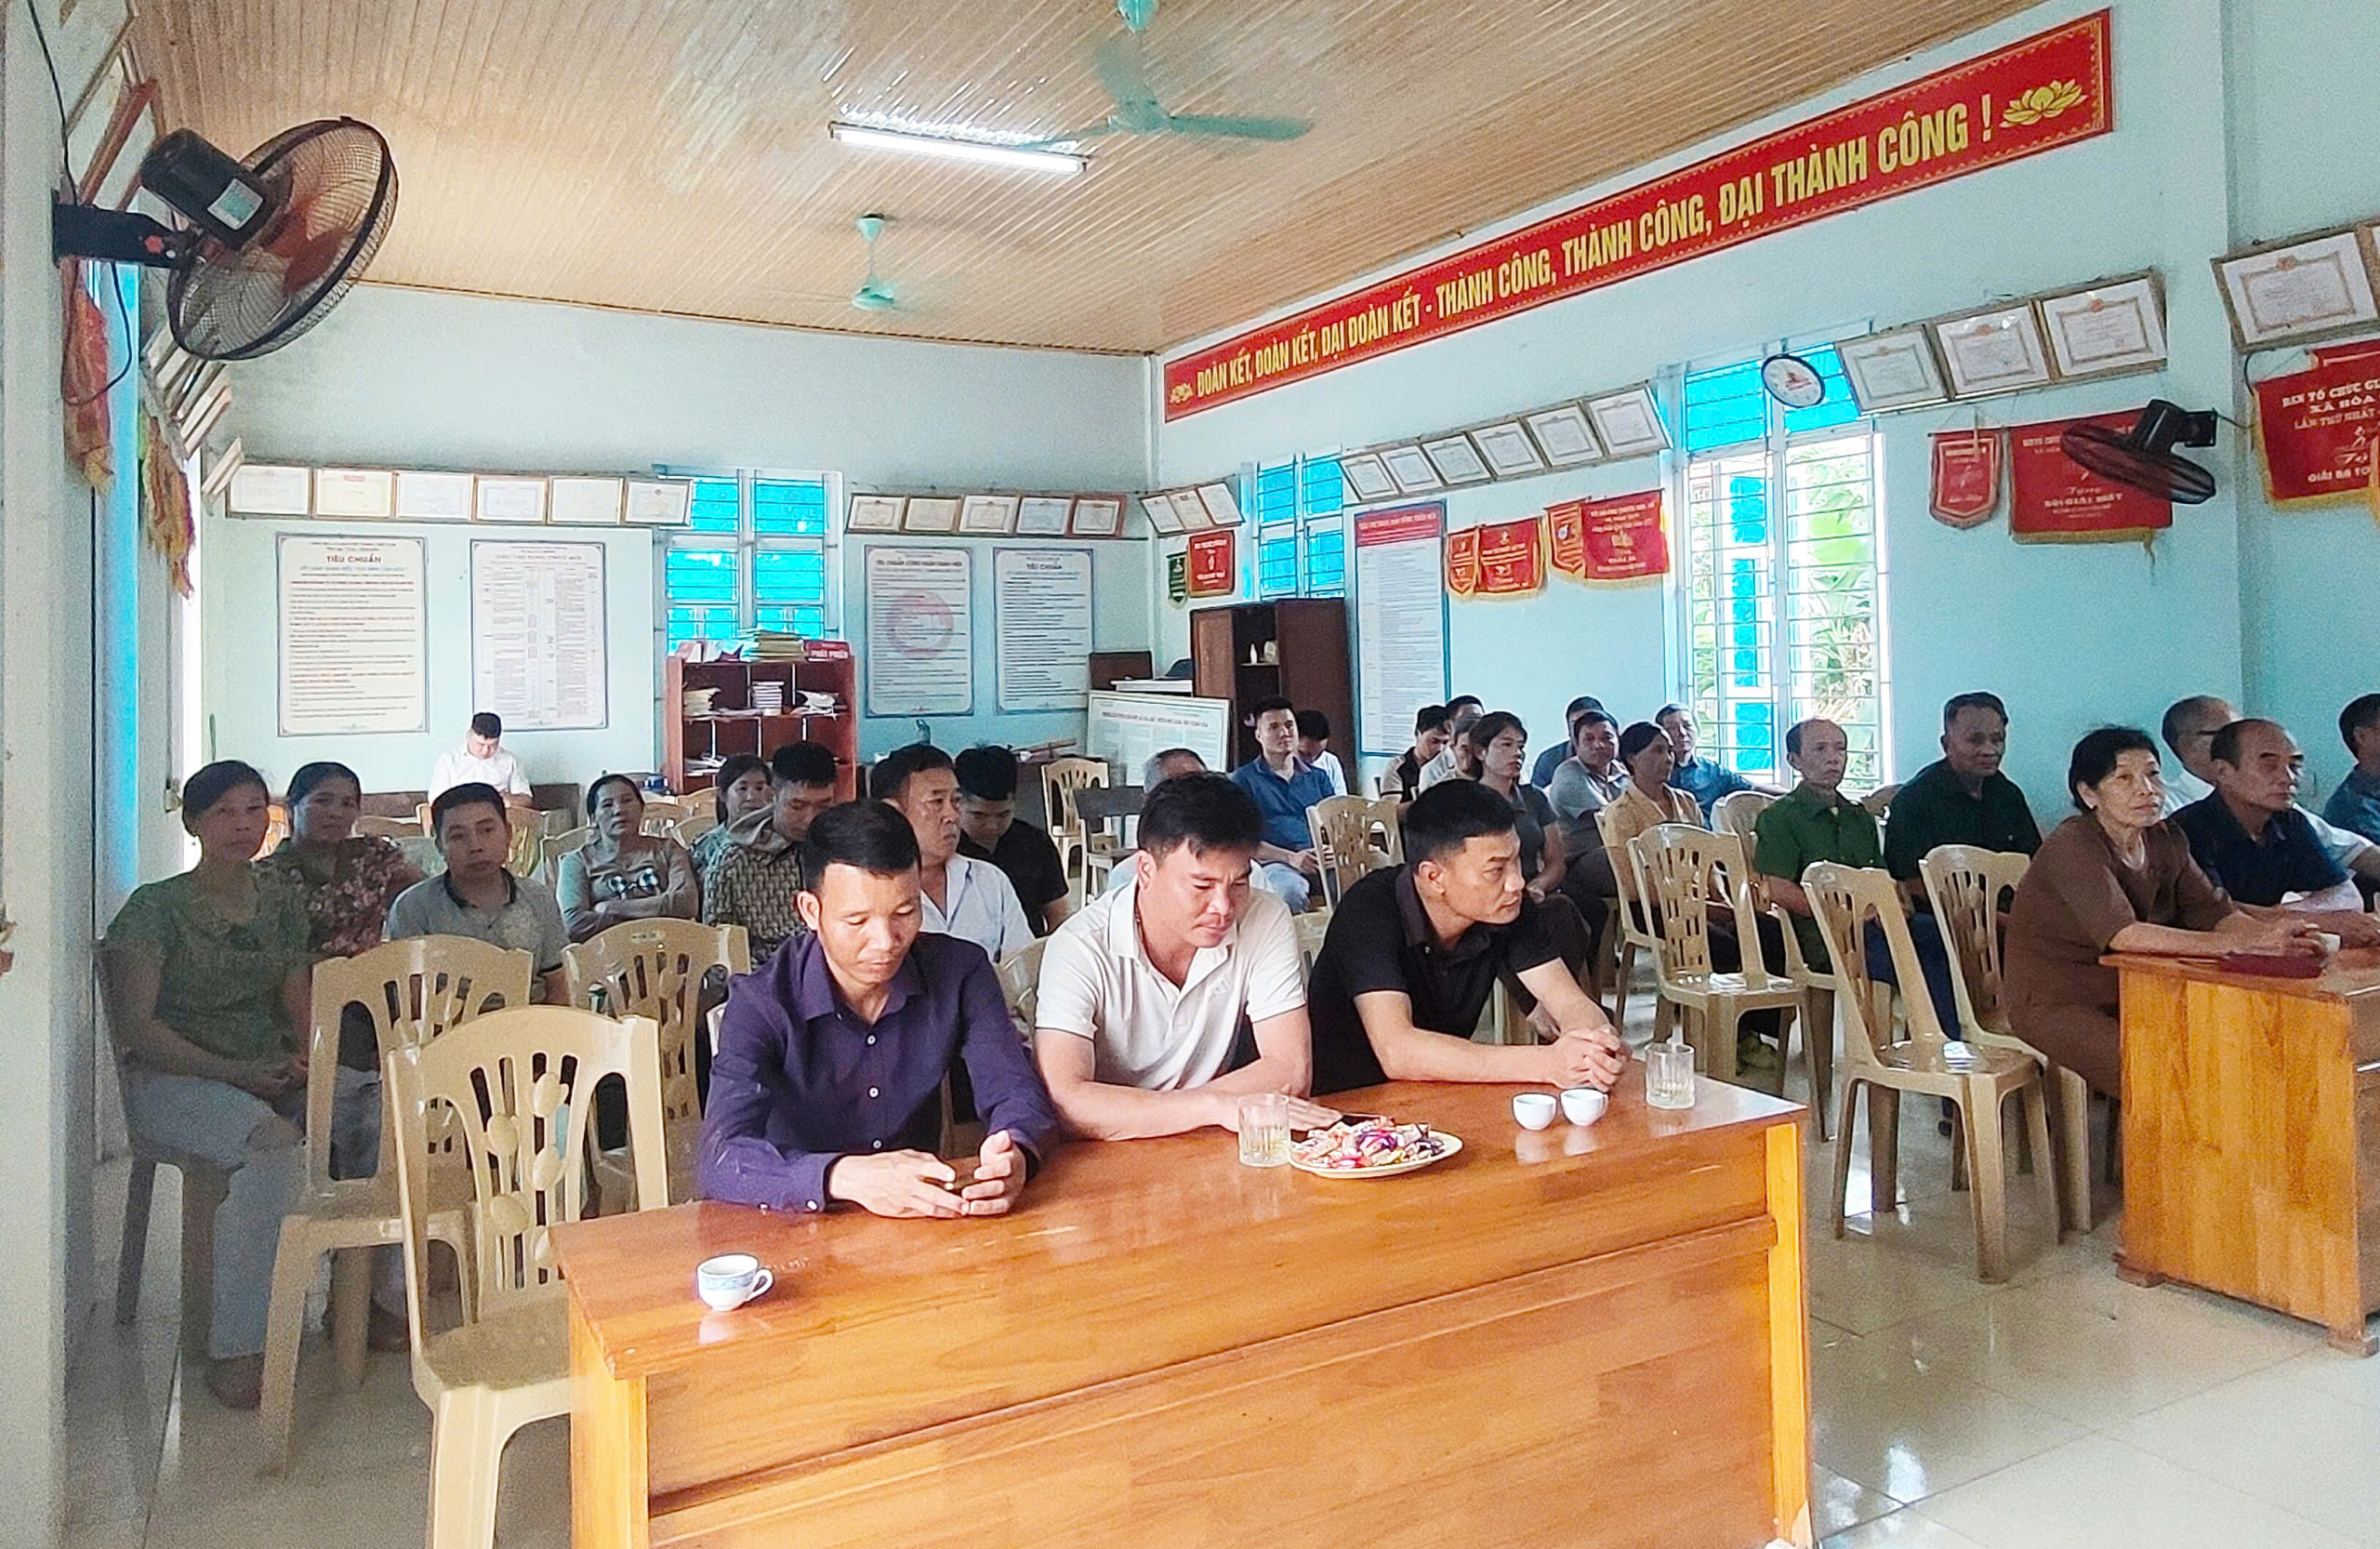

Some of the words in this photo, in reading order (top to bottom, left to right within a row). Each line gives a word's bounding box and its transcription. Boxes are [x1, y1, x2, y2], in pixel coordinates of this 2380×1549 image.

[1229, 346, 1254, 384] KẾT,
[1292, 323, 1318, 364] KẾT,
[1393, 285, 1421, 333] KẾT
[1435, 270, 1494, 319] THÀNH
[1499, 249, 1557, 298] CÔNG,
[1561, 218, 1633, 277] THÀNH
[1639, 193, 1712, 252] CÔNG,
[1719, 171, 1765, 229] ĐẠI
[1770, 135, 1868, 208] THÀNH
[1877, 102, 1969, 174] CÔNG
